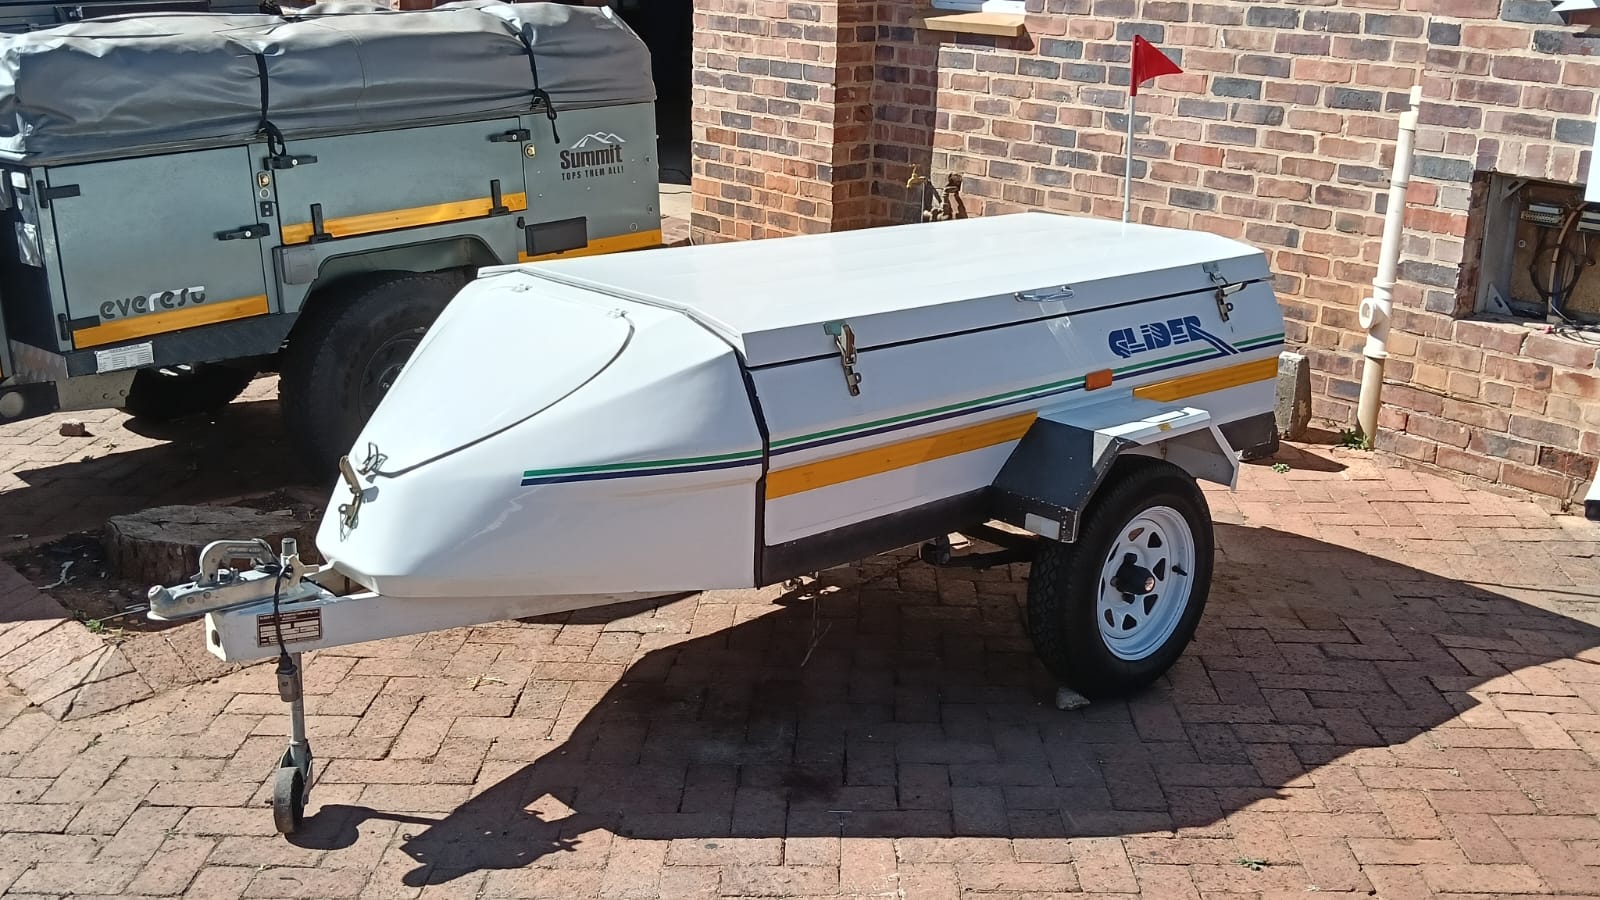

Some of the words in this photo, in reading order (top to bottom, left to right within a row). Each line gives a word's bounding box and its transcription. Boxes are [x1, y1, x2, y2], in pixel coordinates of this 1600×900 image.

[559, 144, 623, 170] Summit
[561, 171, 582, 181] TOPS
[585, 167, 605, 178] THEM
[608, 165, 624, 175] ALL!
[100, 286, 206, 320] everest
